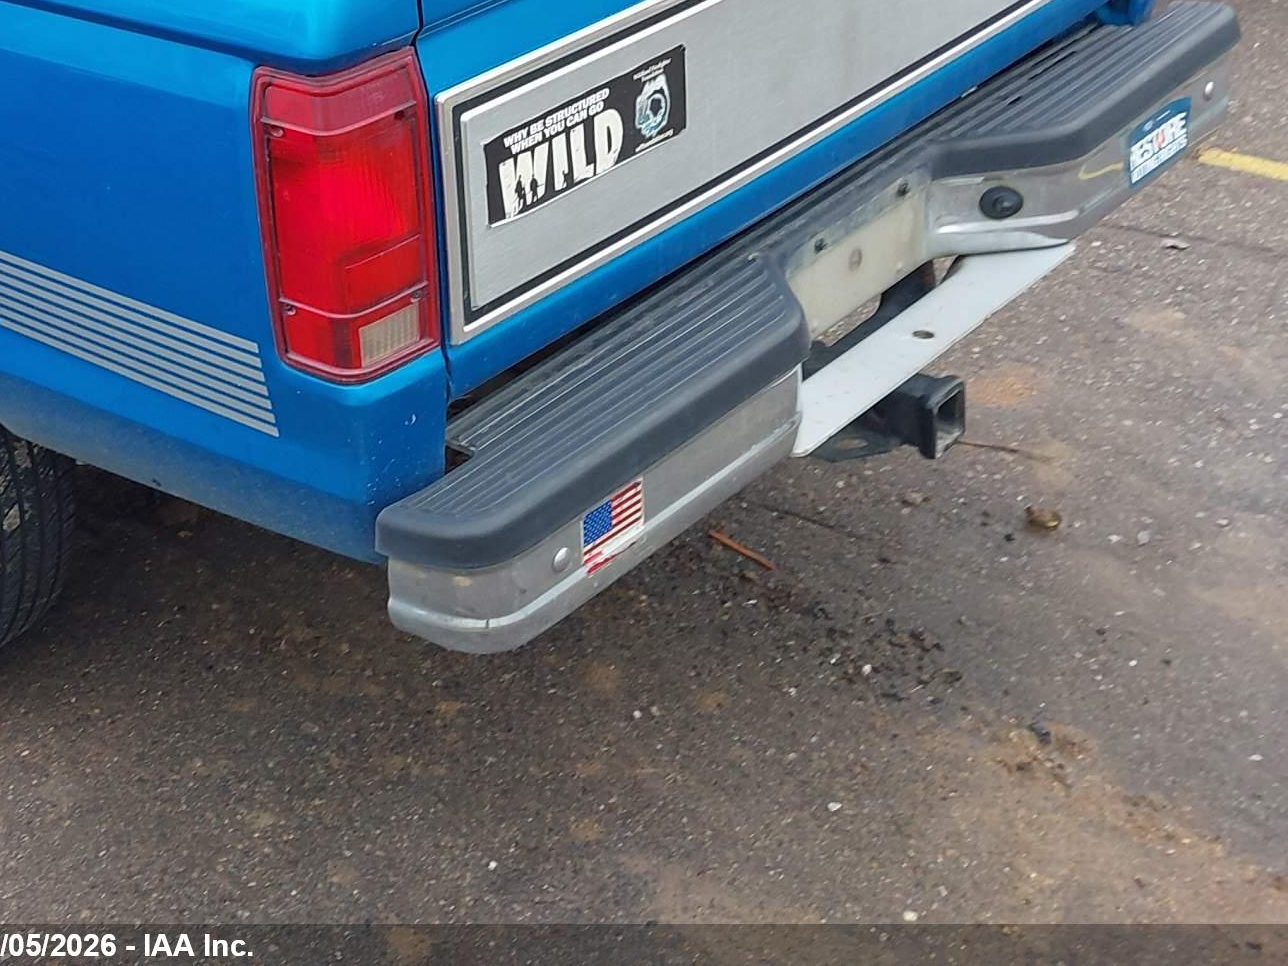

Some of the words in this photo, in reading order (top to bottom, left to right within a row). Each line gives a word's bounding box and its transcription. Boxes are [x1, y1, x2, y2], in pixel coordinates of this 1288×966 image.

[503, 127, 529, 147] WHY
[530, 119, 544, 133] BE
[545, 88, 610, 127] STRUCTURED
[511, 131, 543, 154] WHEN
[544, 120, 566, 138] YOU
[566, 109, 588, 127] CAN
[588, 101, 604, 115] GO
[499, 108, 624, 219] WILD
